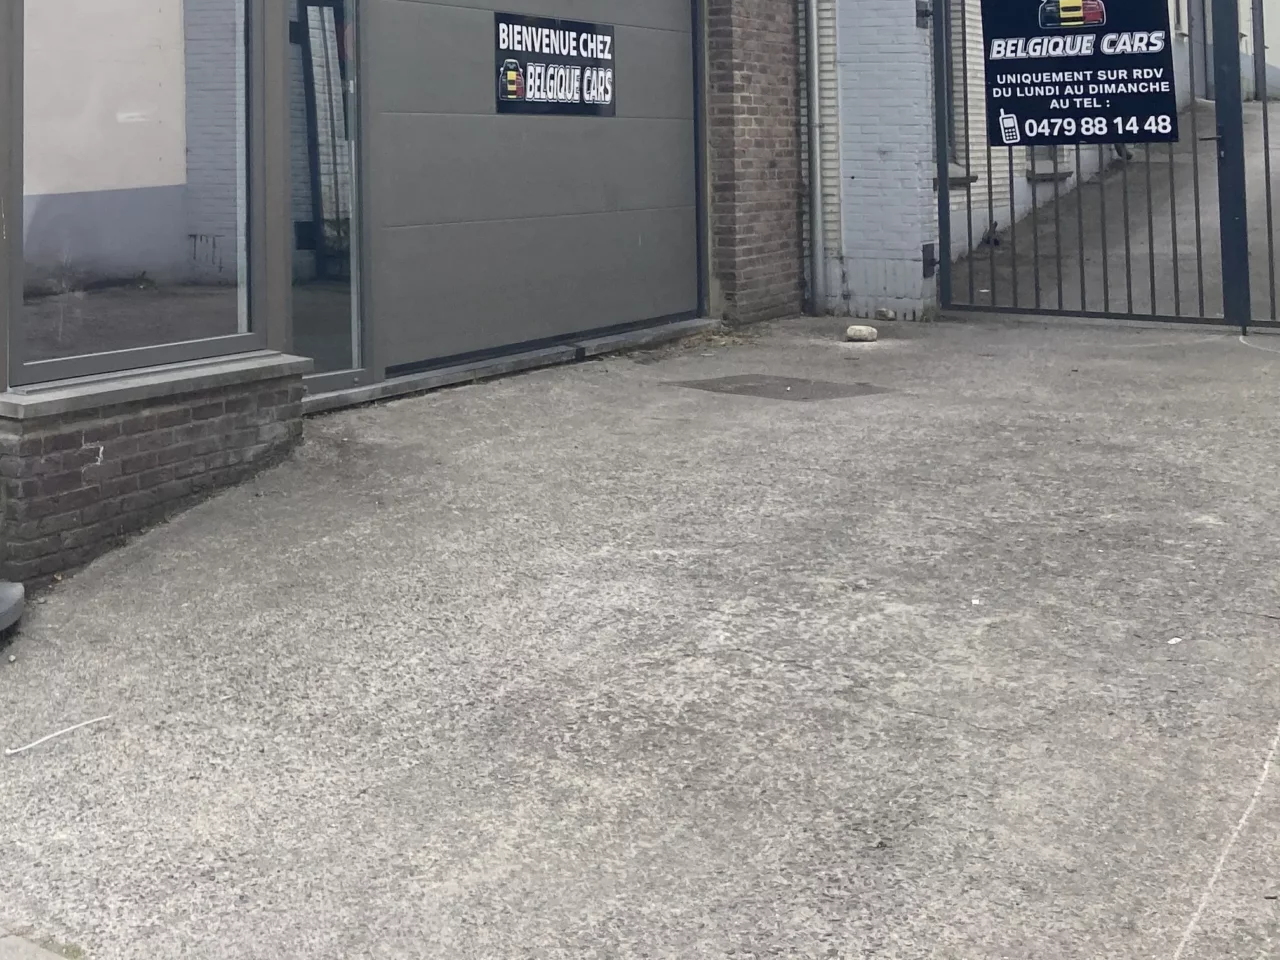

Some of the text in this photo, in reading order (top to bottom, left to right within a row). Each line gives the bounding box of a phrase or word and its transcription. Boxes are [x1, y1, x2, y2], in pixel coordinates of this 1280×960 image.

[498, 22, 612, 60] BIENVENUE CHEZ
[990, 31, 1165, 60] BELGIQUE CARS
[525, 62, 613, 105] BELGIQUE CARS
[996, 68, 1164, 84] UNIQUEMENT SUR RDV
[992, 81, 1170, 98] DU LUNDI AU DIMANCHE
[1050, 98, 1069, 109] AU
[1024, 115, 1172, 137] 0479 88 14 48
